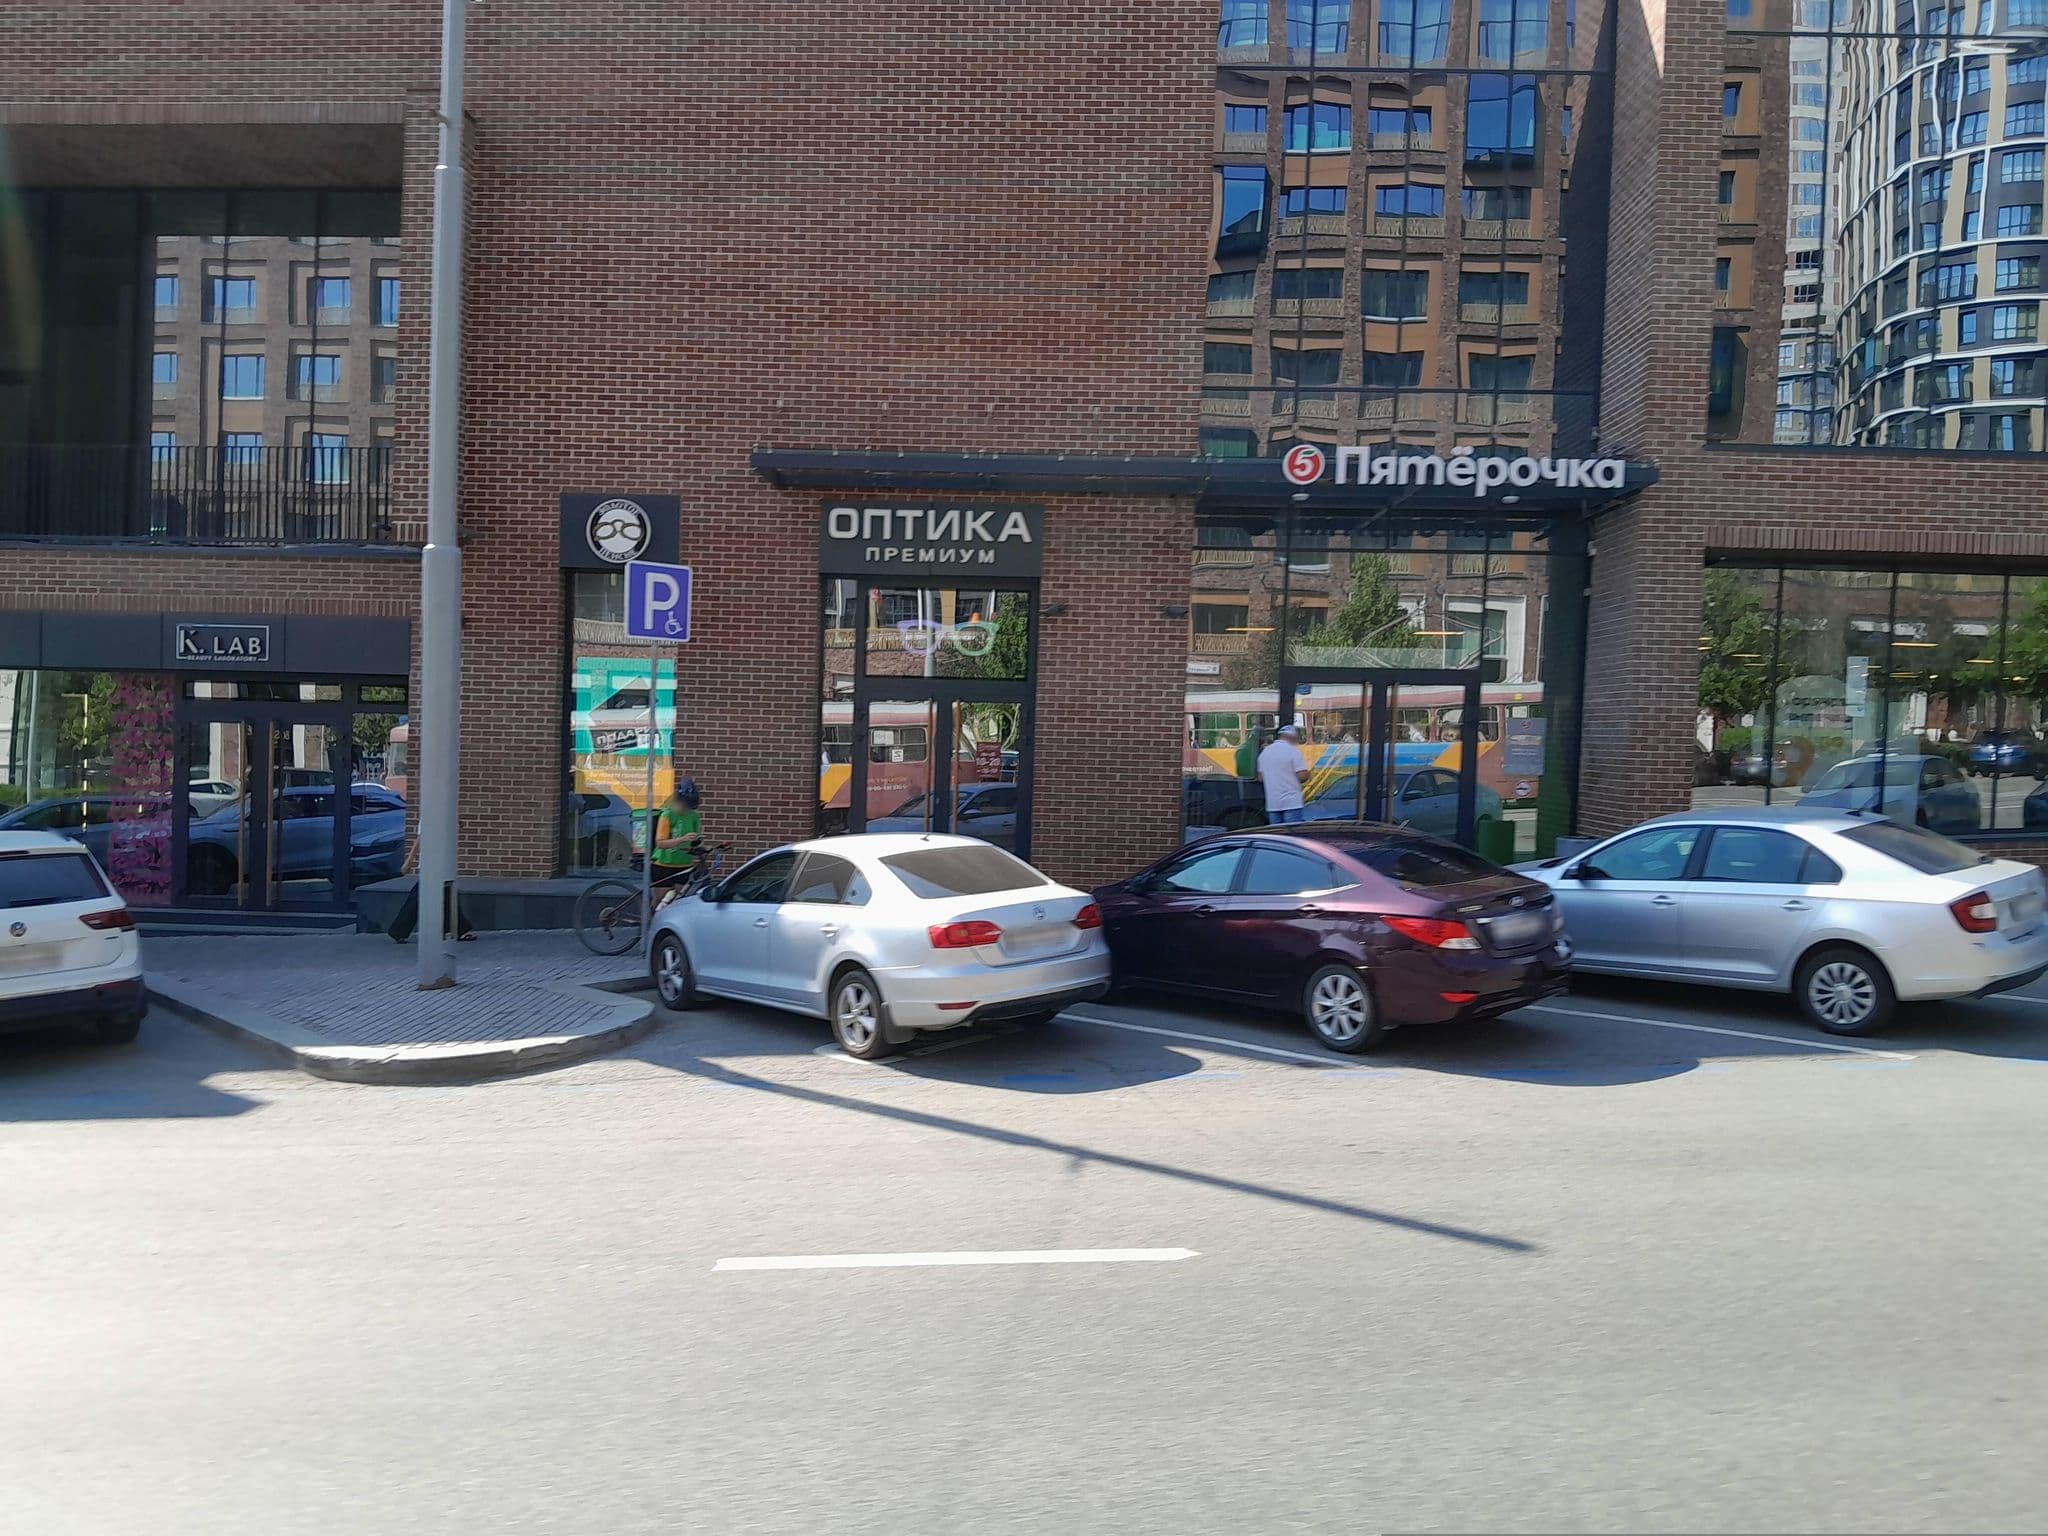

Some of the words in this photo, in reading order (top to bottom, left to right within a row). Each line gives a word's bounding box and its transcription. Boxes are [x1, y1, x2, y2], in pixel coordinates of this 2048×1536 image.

[1335, 445, 1625, 497] Пятёрочка
[828, 507, 1033, 543] ОПТИКА
[865, 546, 996, 564] ПРЕМИУМ
[644, 572, 680, 630] P
[213, 636, 262, 655] LAB
